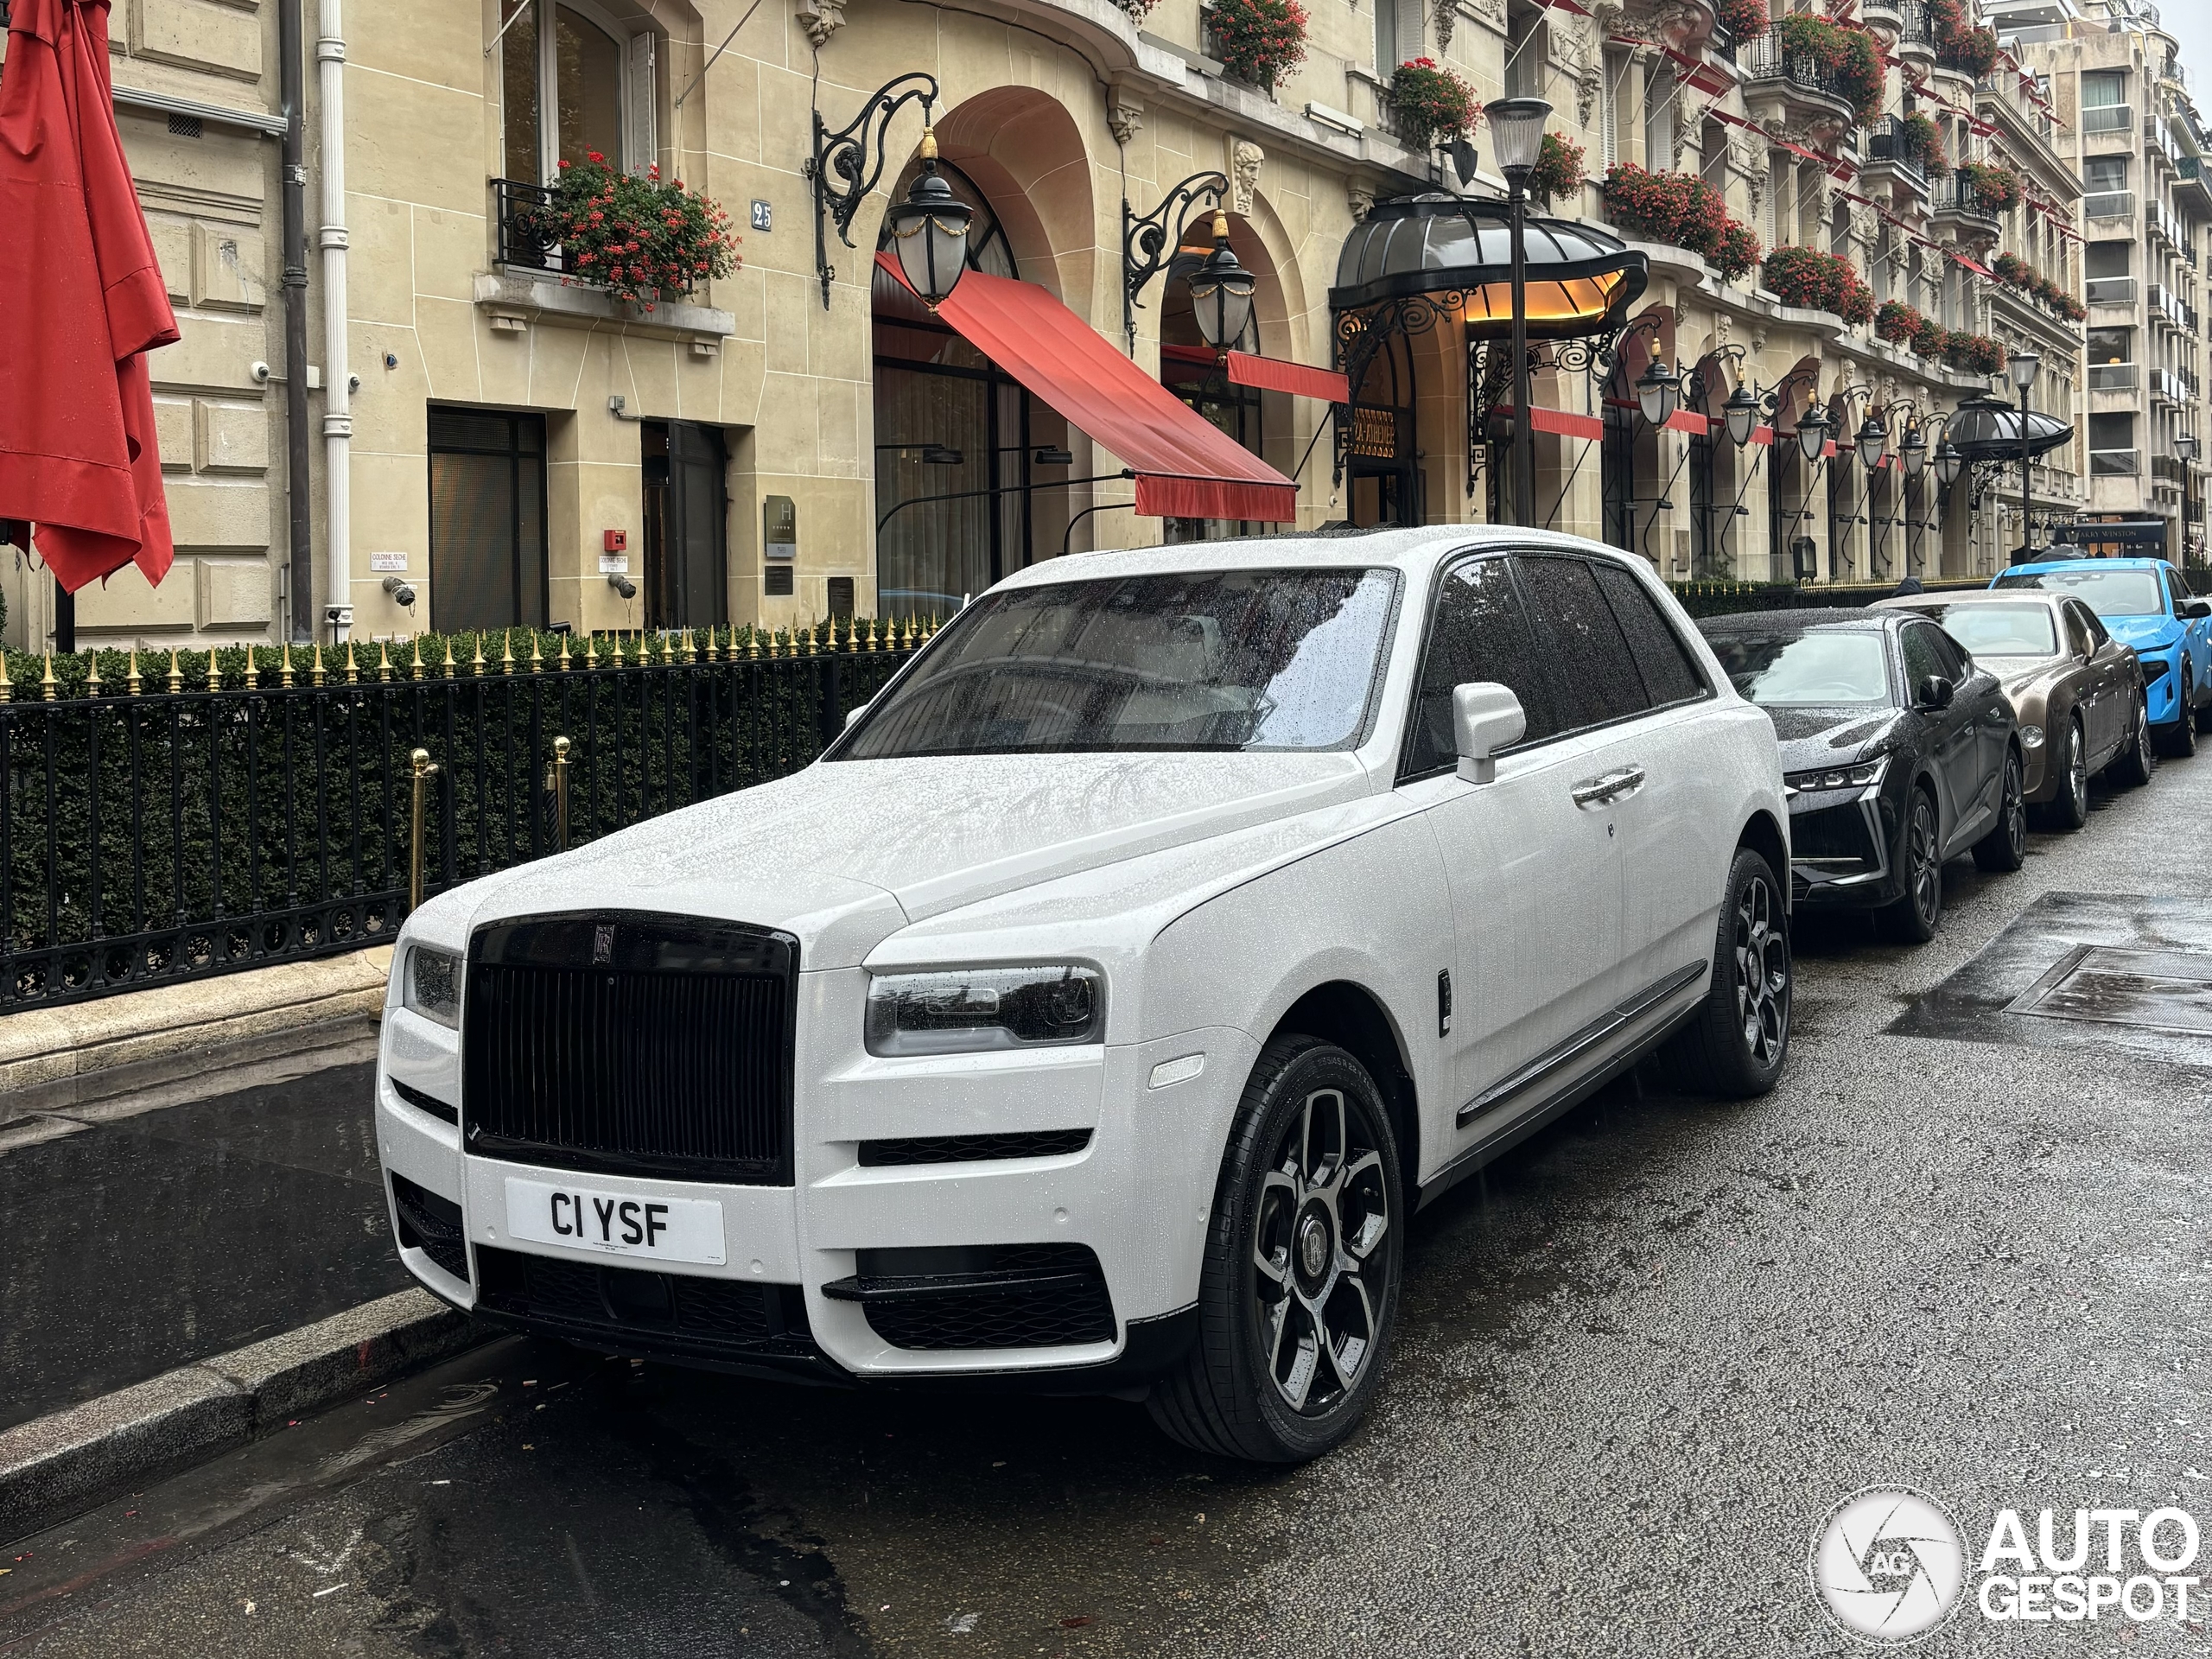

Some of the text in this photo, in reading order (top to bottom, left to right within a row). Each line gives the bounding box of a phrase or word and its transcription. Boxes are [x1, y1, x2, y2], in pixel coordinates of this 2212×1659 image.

[754, 202, 771, 227] 25
[781, 504, 791, 520] H
[593, 1197, 669, 1247] YSF
